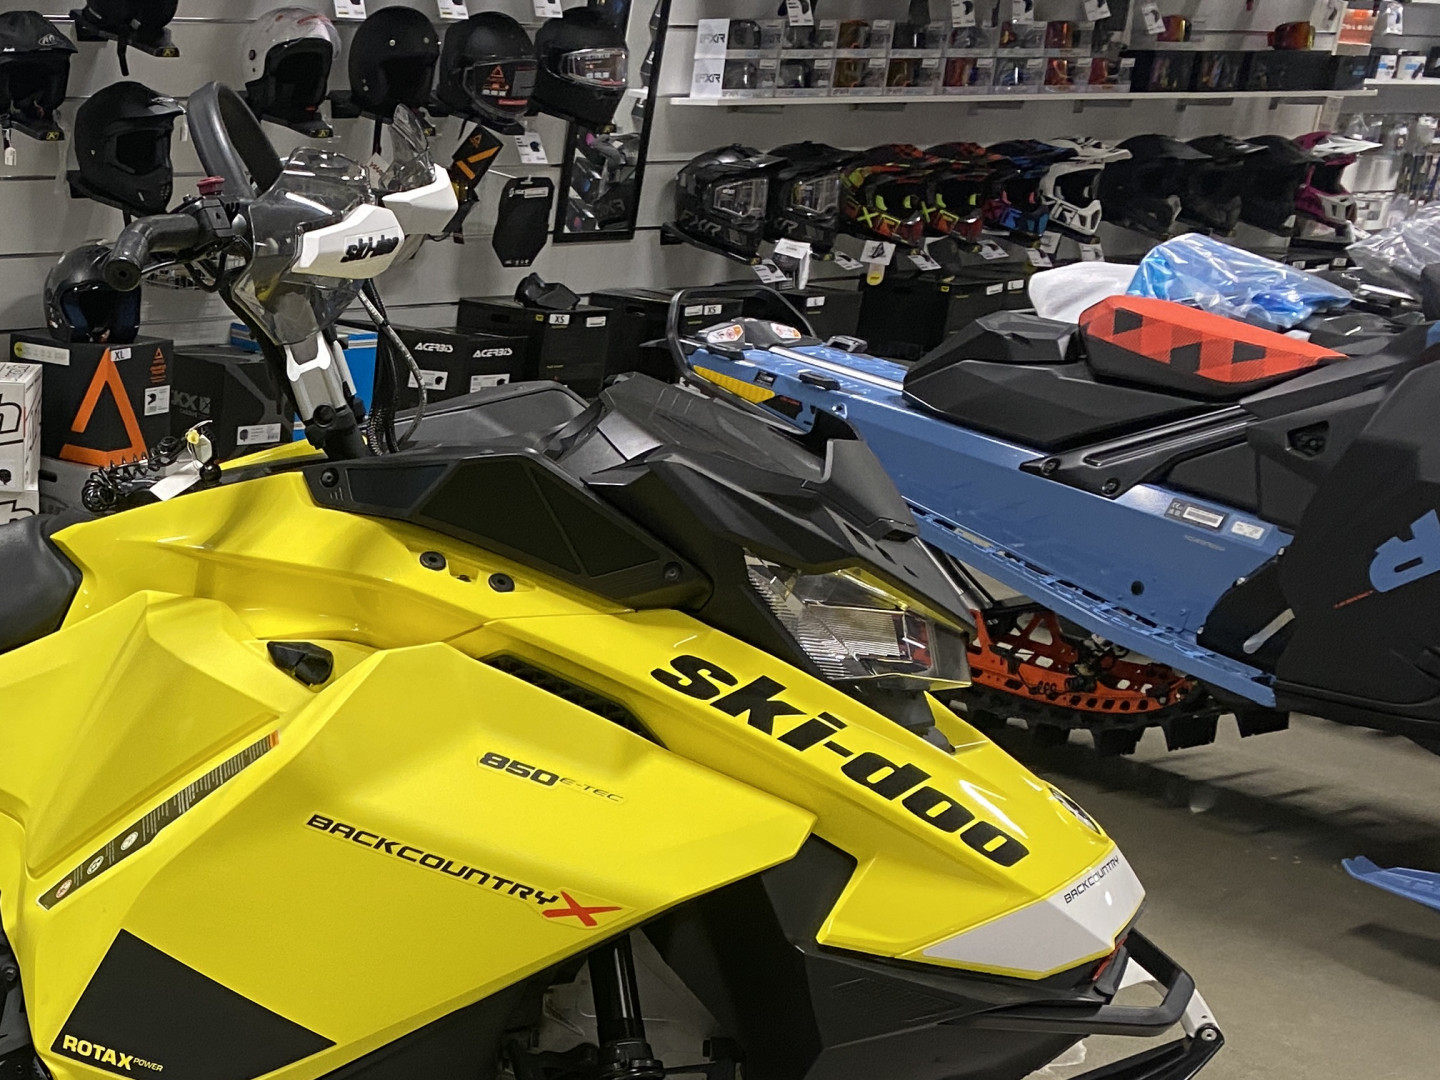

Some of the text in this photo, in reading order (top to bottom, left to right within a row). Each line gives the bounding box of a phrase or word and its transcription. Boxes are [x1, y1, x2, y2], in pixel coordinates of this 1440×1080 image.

[114, 351, 125, 360] XL
[414, 342, 454, 353] ACERBIS
[472, 347, 513, 358] ACERBIS
[479, 751, 624, 802] 850 E-TEC
[650, 654, 1030, 868] ski-doo
[306, 814, 560, 905] BACKCOUNTRY
[1063, 855, 1120, 904] BACKCOUNTRY
[62, 1034, 164, 1072] ROTAX POWER
